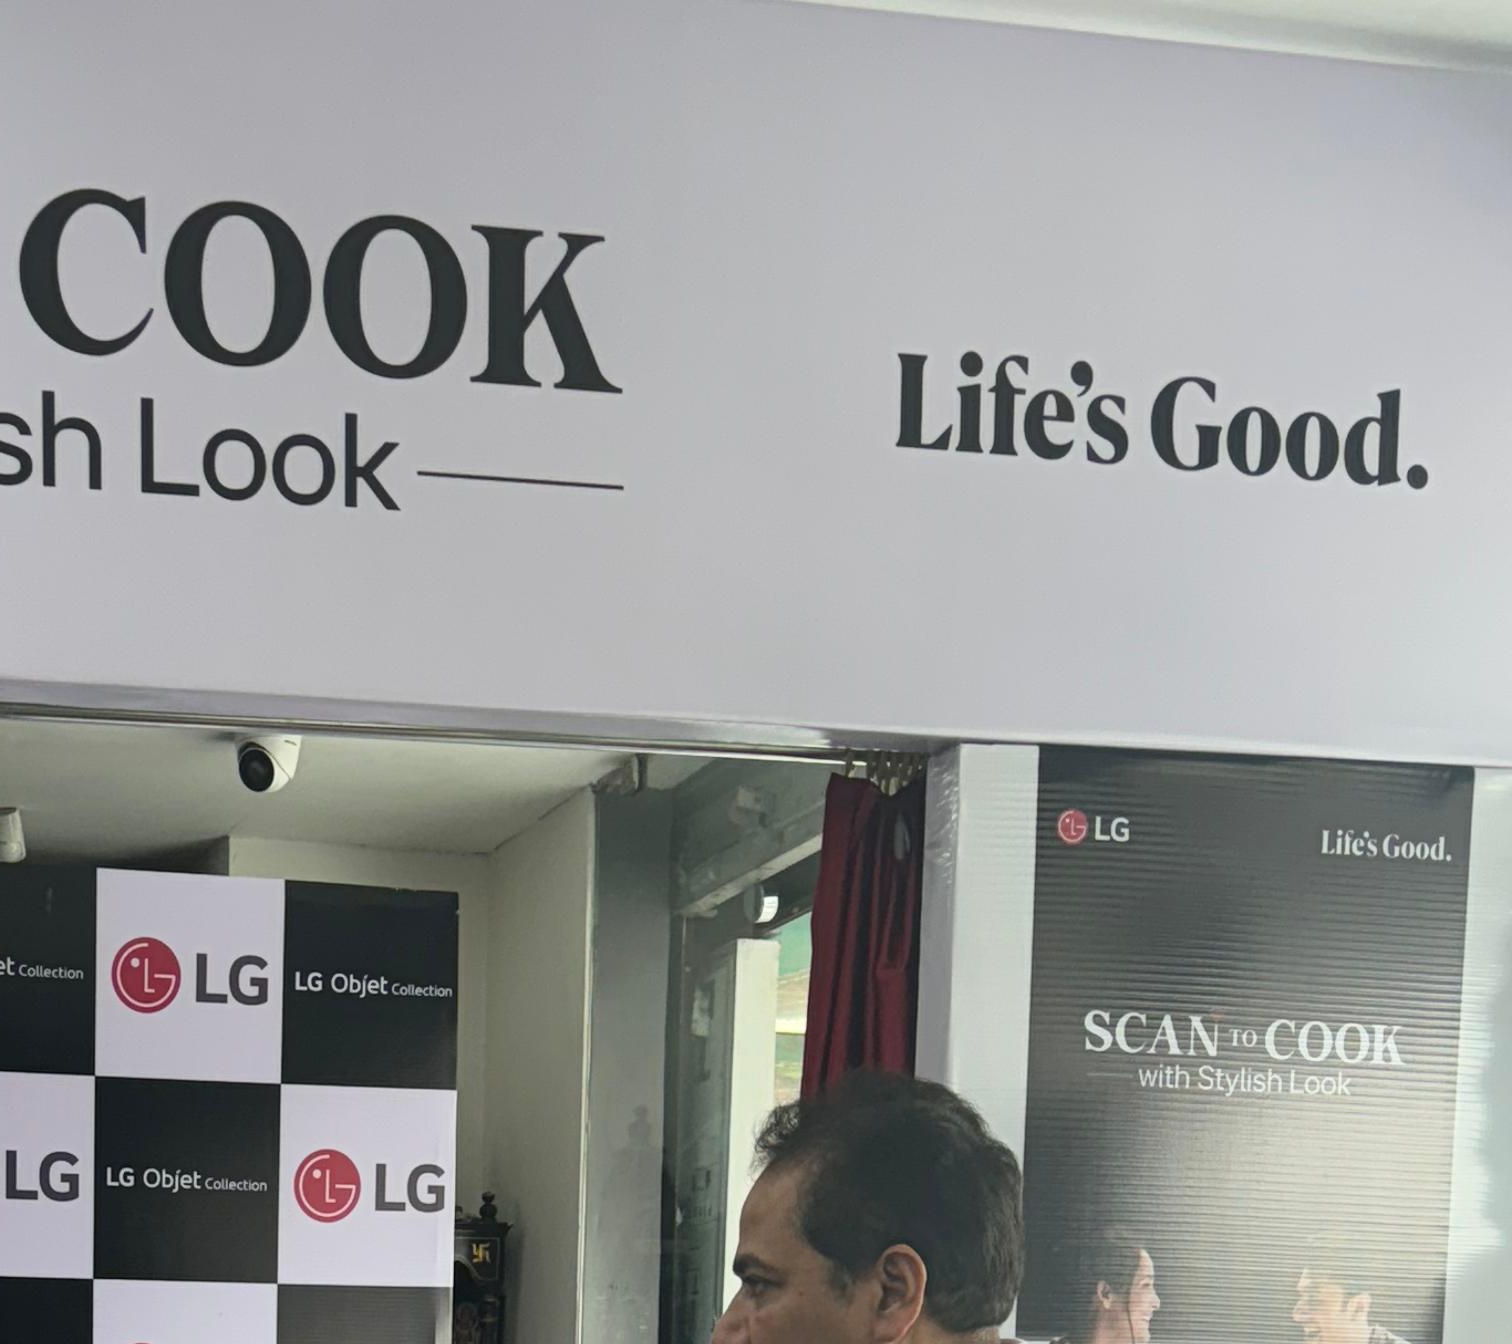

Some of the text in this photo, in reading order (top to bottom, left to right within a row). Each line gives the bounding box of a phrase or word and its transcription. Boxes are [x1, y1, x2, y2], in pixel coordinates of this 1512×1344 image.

[19, 189, 622, 393] COOK
[895, 353, 1428, 489] Life's Good.
[141, 398, 400, 510] Look
[1095, 816, 1129, 842] LG
[1322, 830, 1451, 861] Life's Good.
[196, 953, 268, 1005] LG
[296, 972, 322, 991] LG
[392, 983, 452, 997] Collection
[1084, 1010, 1405, 1065] SCAN TO COOK
[1139, 1064, 1351, 1096] with Stylish Look
[6, 1150, 79, 1202] LG
[375, 1164, 445, 1212] LG
